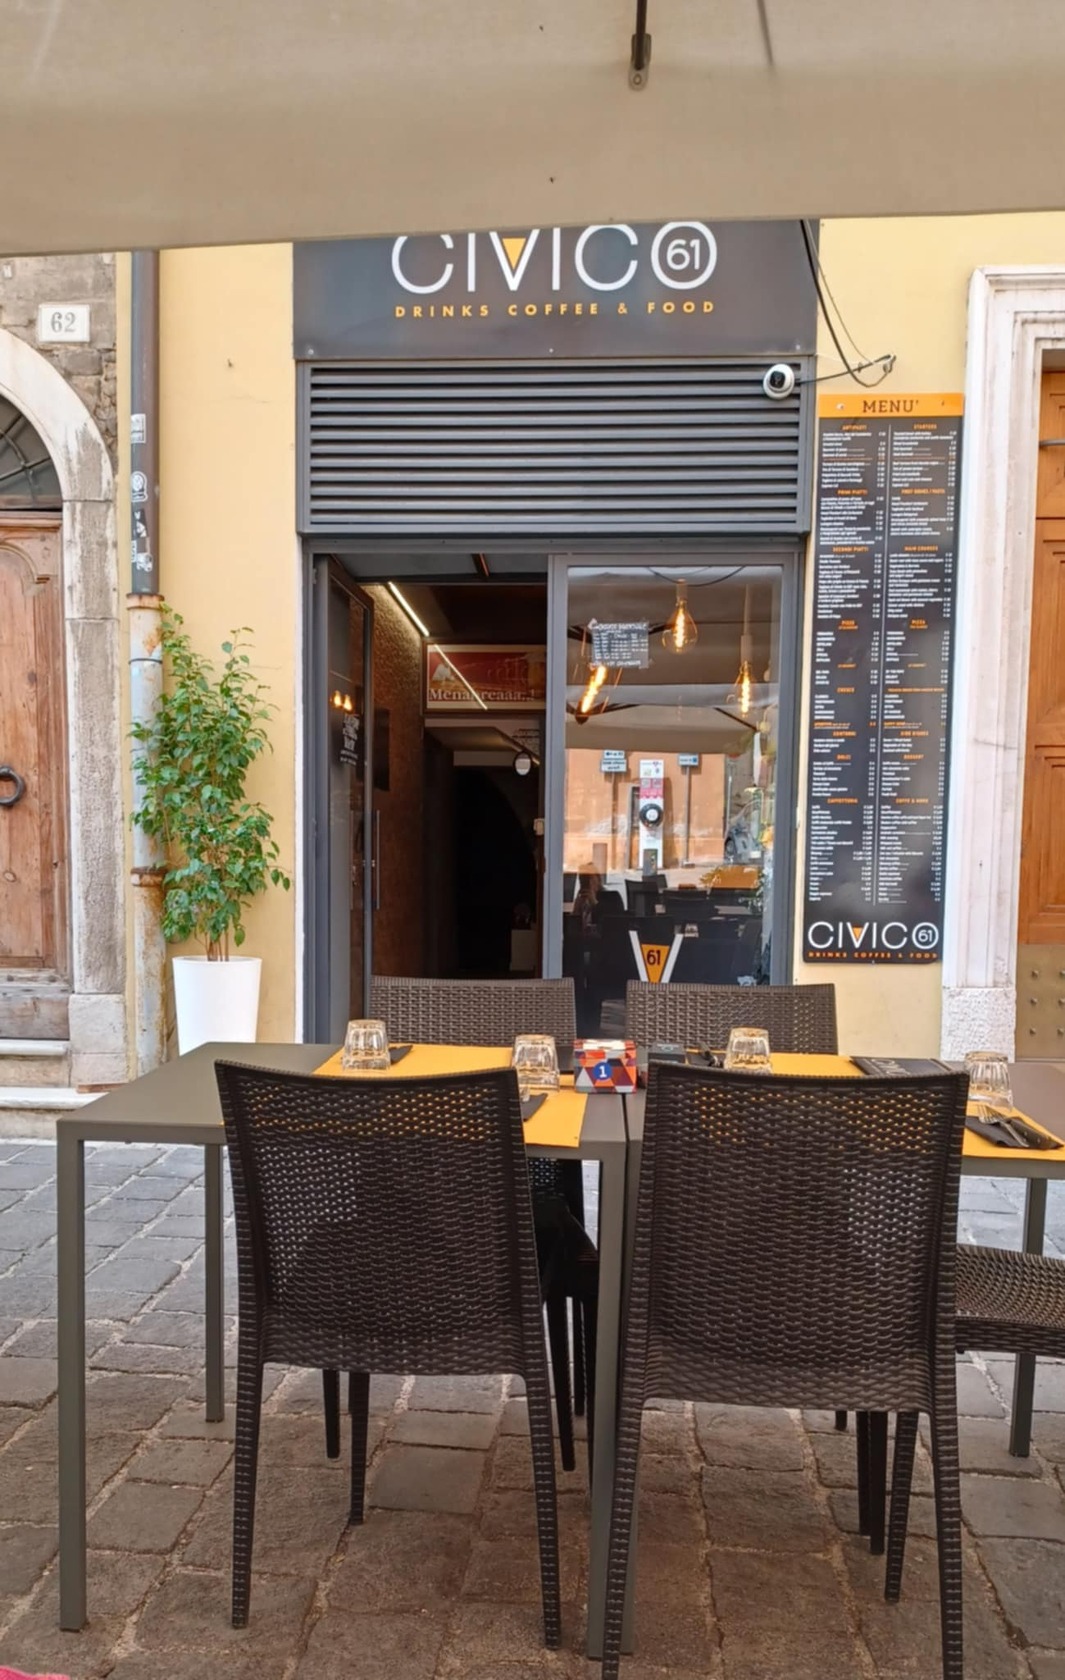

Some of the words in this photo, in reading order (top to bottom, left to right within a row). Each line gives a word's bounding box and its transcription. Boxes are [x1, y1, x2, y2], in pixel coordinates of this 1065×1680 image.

[394, 305, 489, 318] DRINKS
[507, 303, 598, 317] COFFEE
[617, 302, 628, 315] &
[647, 300, 714, 314] FOOD
[50, 311, 77, 333] 62
[862, 399, 919, 414] MENU'
[807, 921, 939, 950] CIVICO
[646, 950, 661, 966] 61
[854, 951, 891, 959] COFFEE
[599, 1065, 607, 1078] 1
